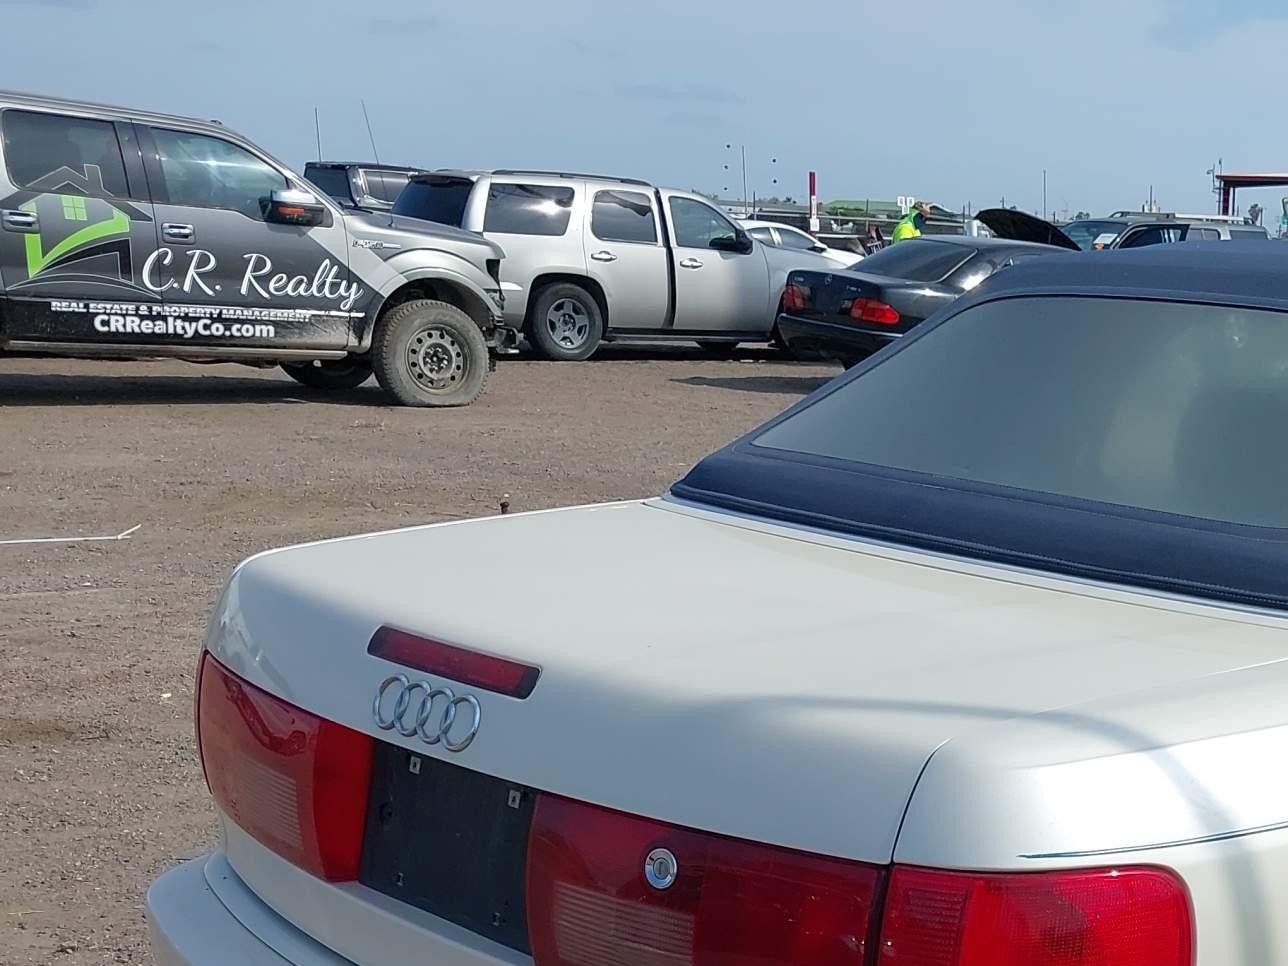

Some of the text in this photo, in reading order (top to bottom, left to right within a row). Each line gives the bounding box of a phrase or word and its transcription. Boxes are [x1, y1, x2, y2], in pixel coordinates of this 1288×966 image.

[142, 248, 365, 311] C.R. Realty
[51, 301, 312, 322] REAL ESTATE & PROPERTY MANAGEMENT
[94, 313, 275, 338] CRRealtyCo.com
